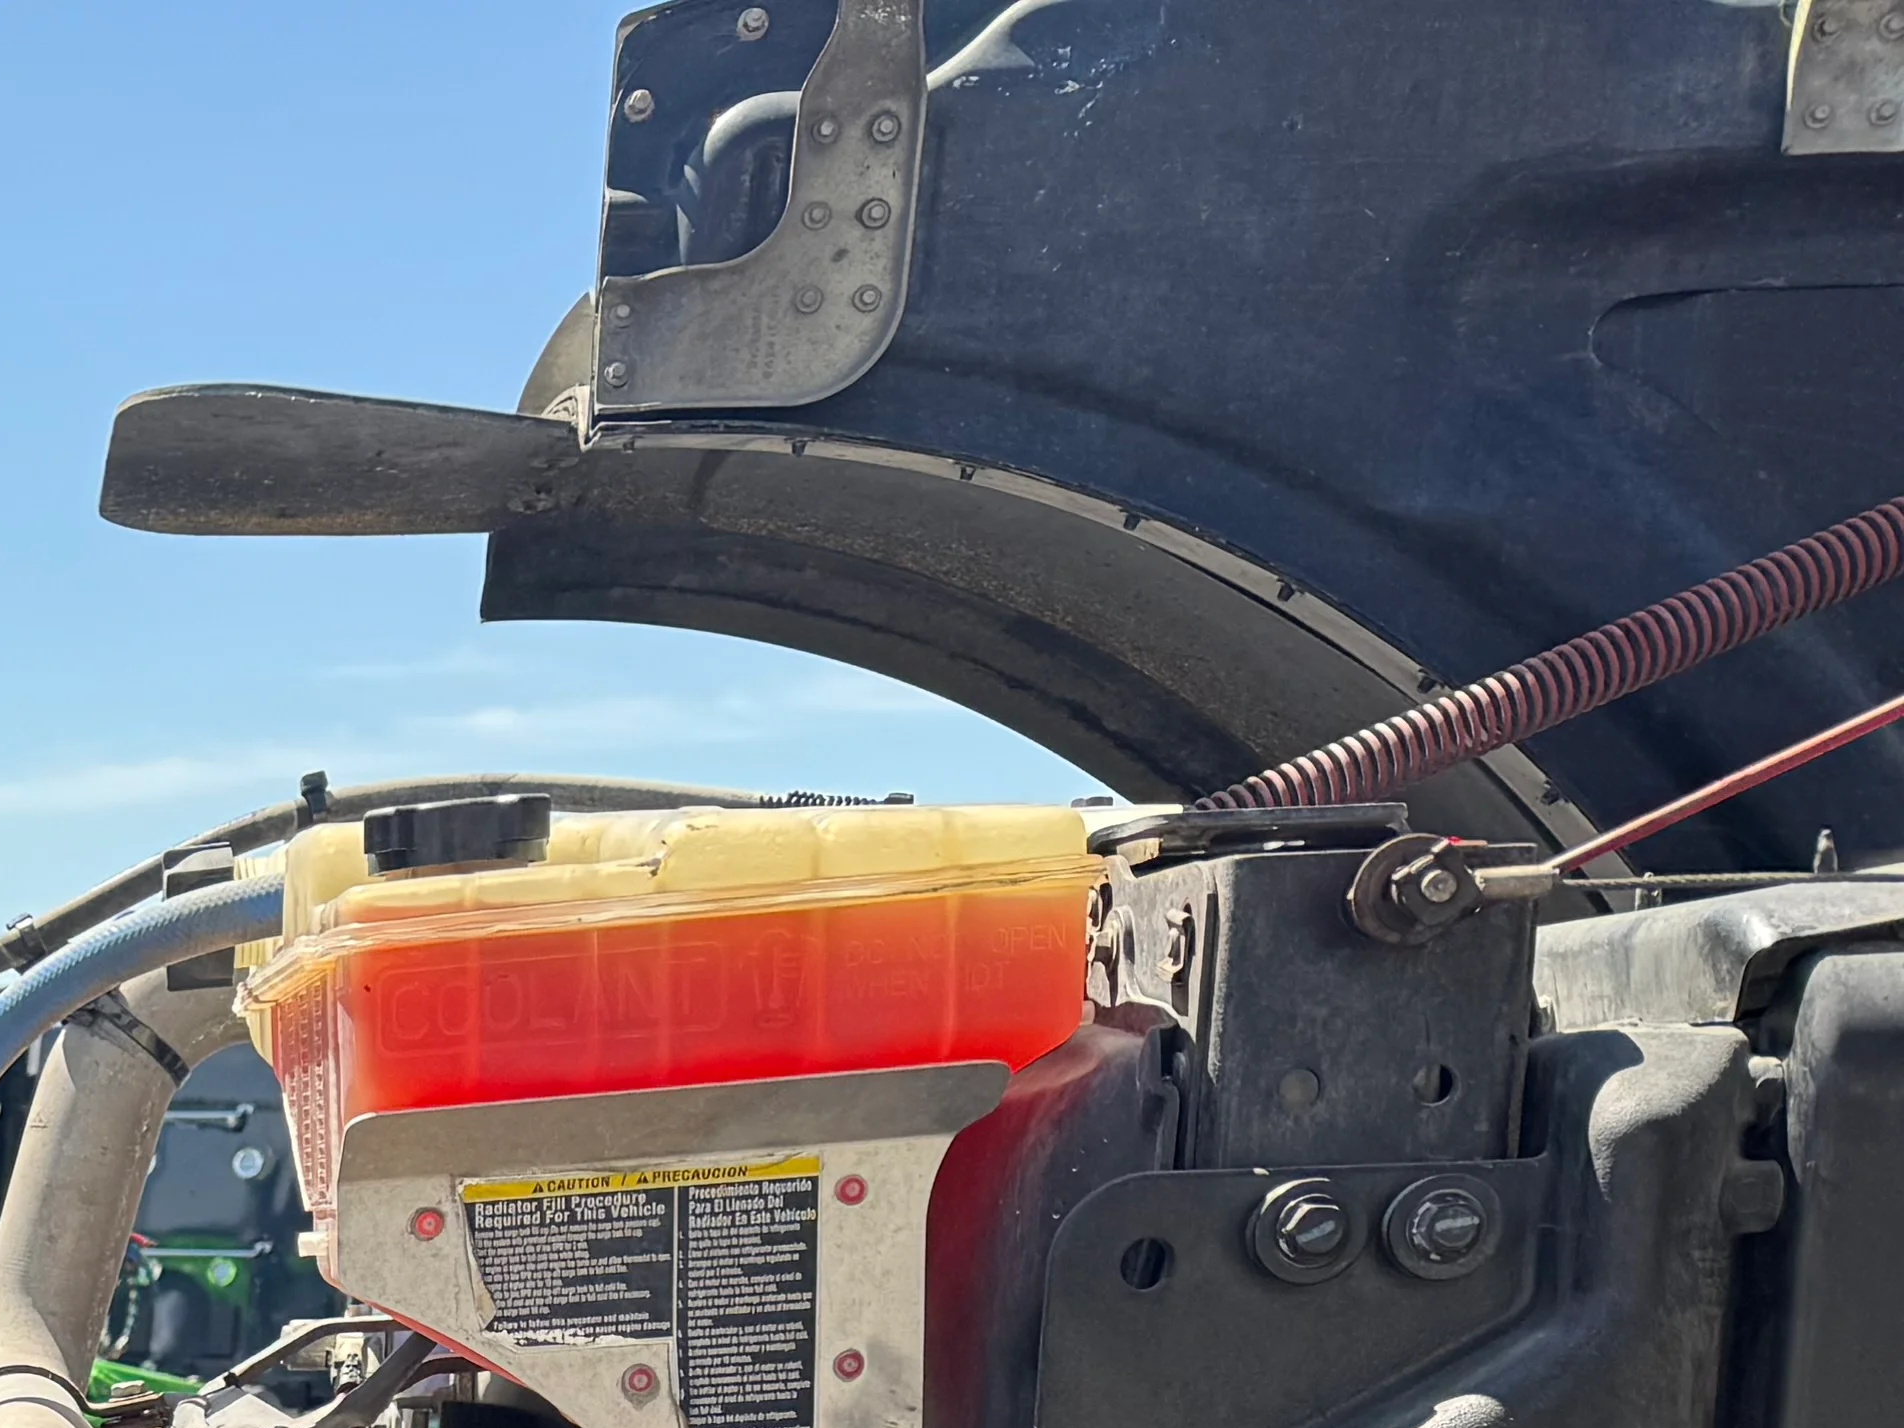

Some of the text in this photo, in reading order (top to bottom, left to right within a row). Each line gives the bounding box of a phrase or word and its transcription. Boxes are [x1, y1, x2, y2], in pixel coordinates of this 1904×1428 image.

[546, 1164, 748, 1192] CAUTION PRECAUCION
[474, 1189, 646, 1217] Radiator Fill Procedure
[474, 1200, 665, 1229] Required For This Vehicle
